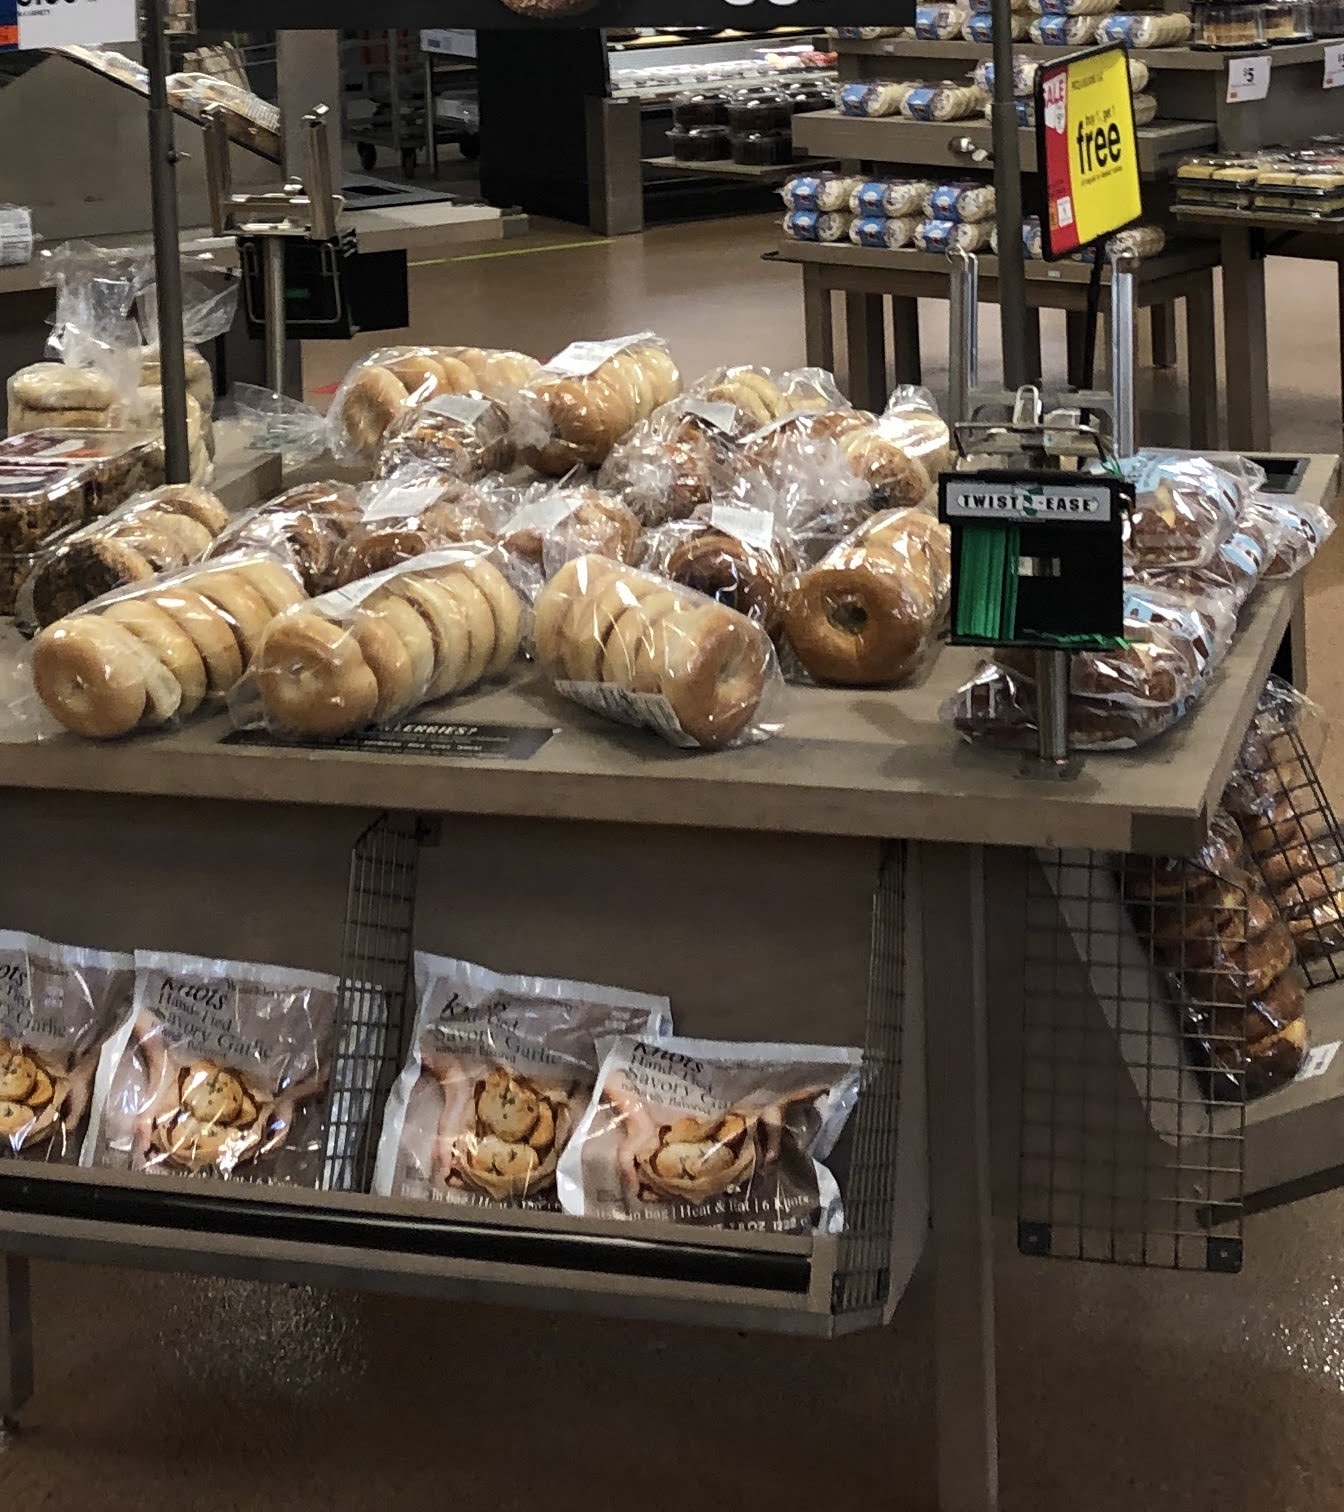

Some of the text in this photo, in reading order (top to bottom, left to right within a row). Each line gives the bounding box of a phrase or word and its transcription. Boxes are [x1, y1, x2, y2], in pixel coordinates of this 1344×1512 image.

[1076, 119, 1122, 175] free
[962, 494, 1091, 511] TWIST EASE
[161, 977, 229, 1010] knots
[714, 1202, 727, 1214] &
[761, 1200, 771, 1211] 6
